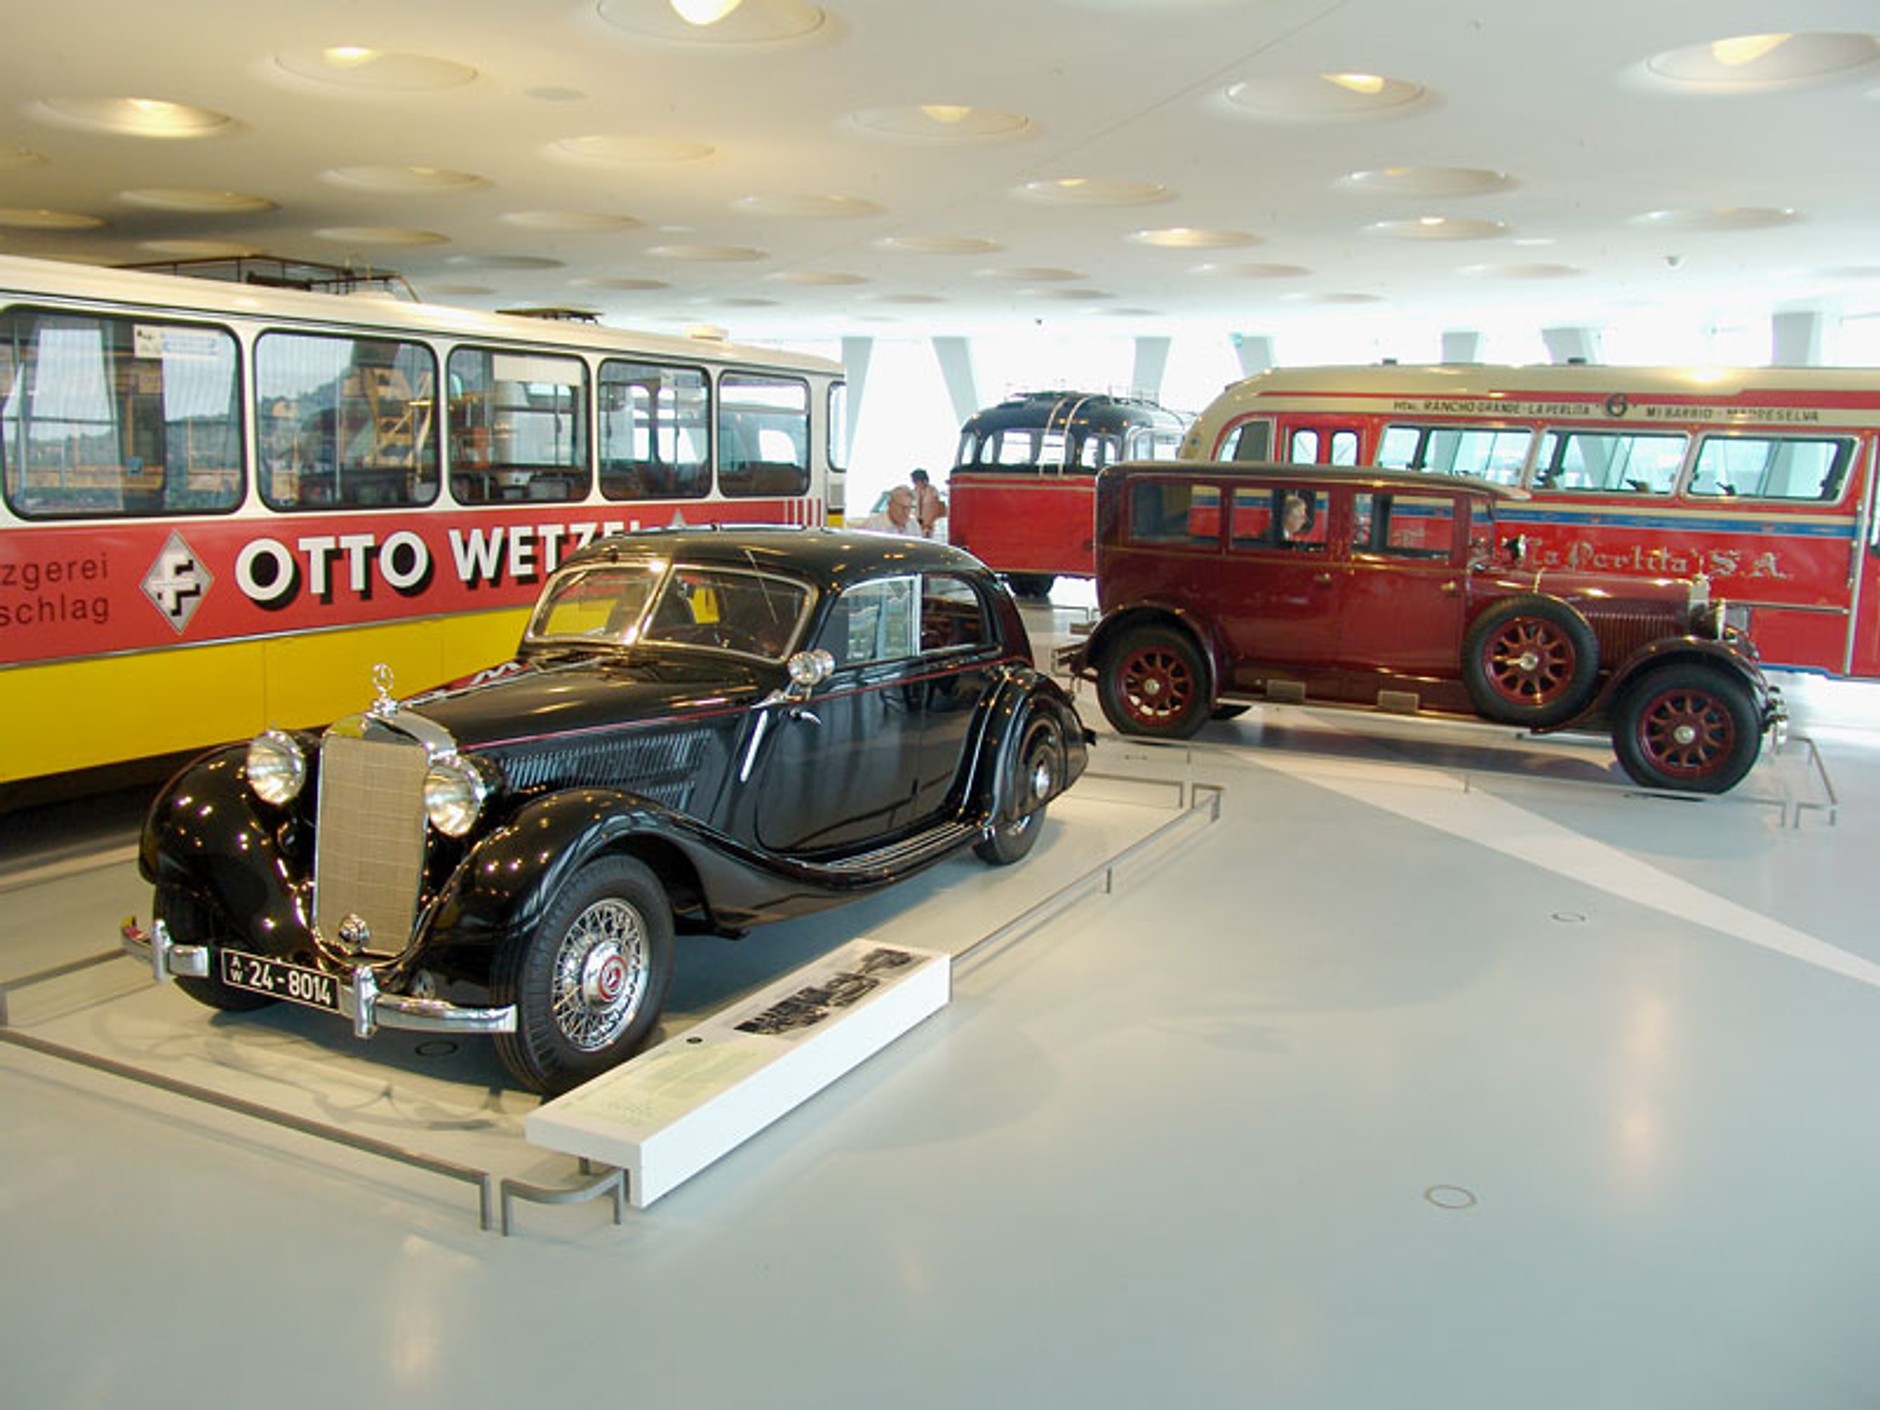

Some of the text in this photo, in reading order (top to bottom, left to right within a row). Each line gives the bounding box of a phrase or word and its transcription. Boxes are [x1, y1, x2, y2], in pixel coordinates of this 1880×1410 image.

[234, 520, 640, 602] OTTO WETZ
[0, 593, 110, 627] schlag
[249, 961, 332, 1005] 24-8014
